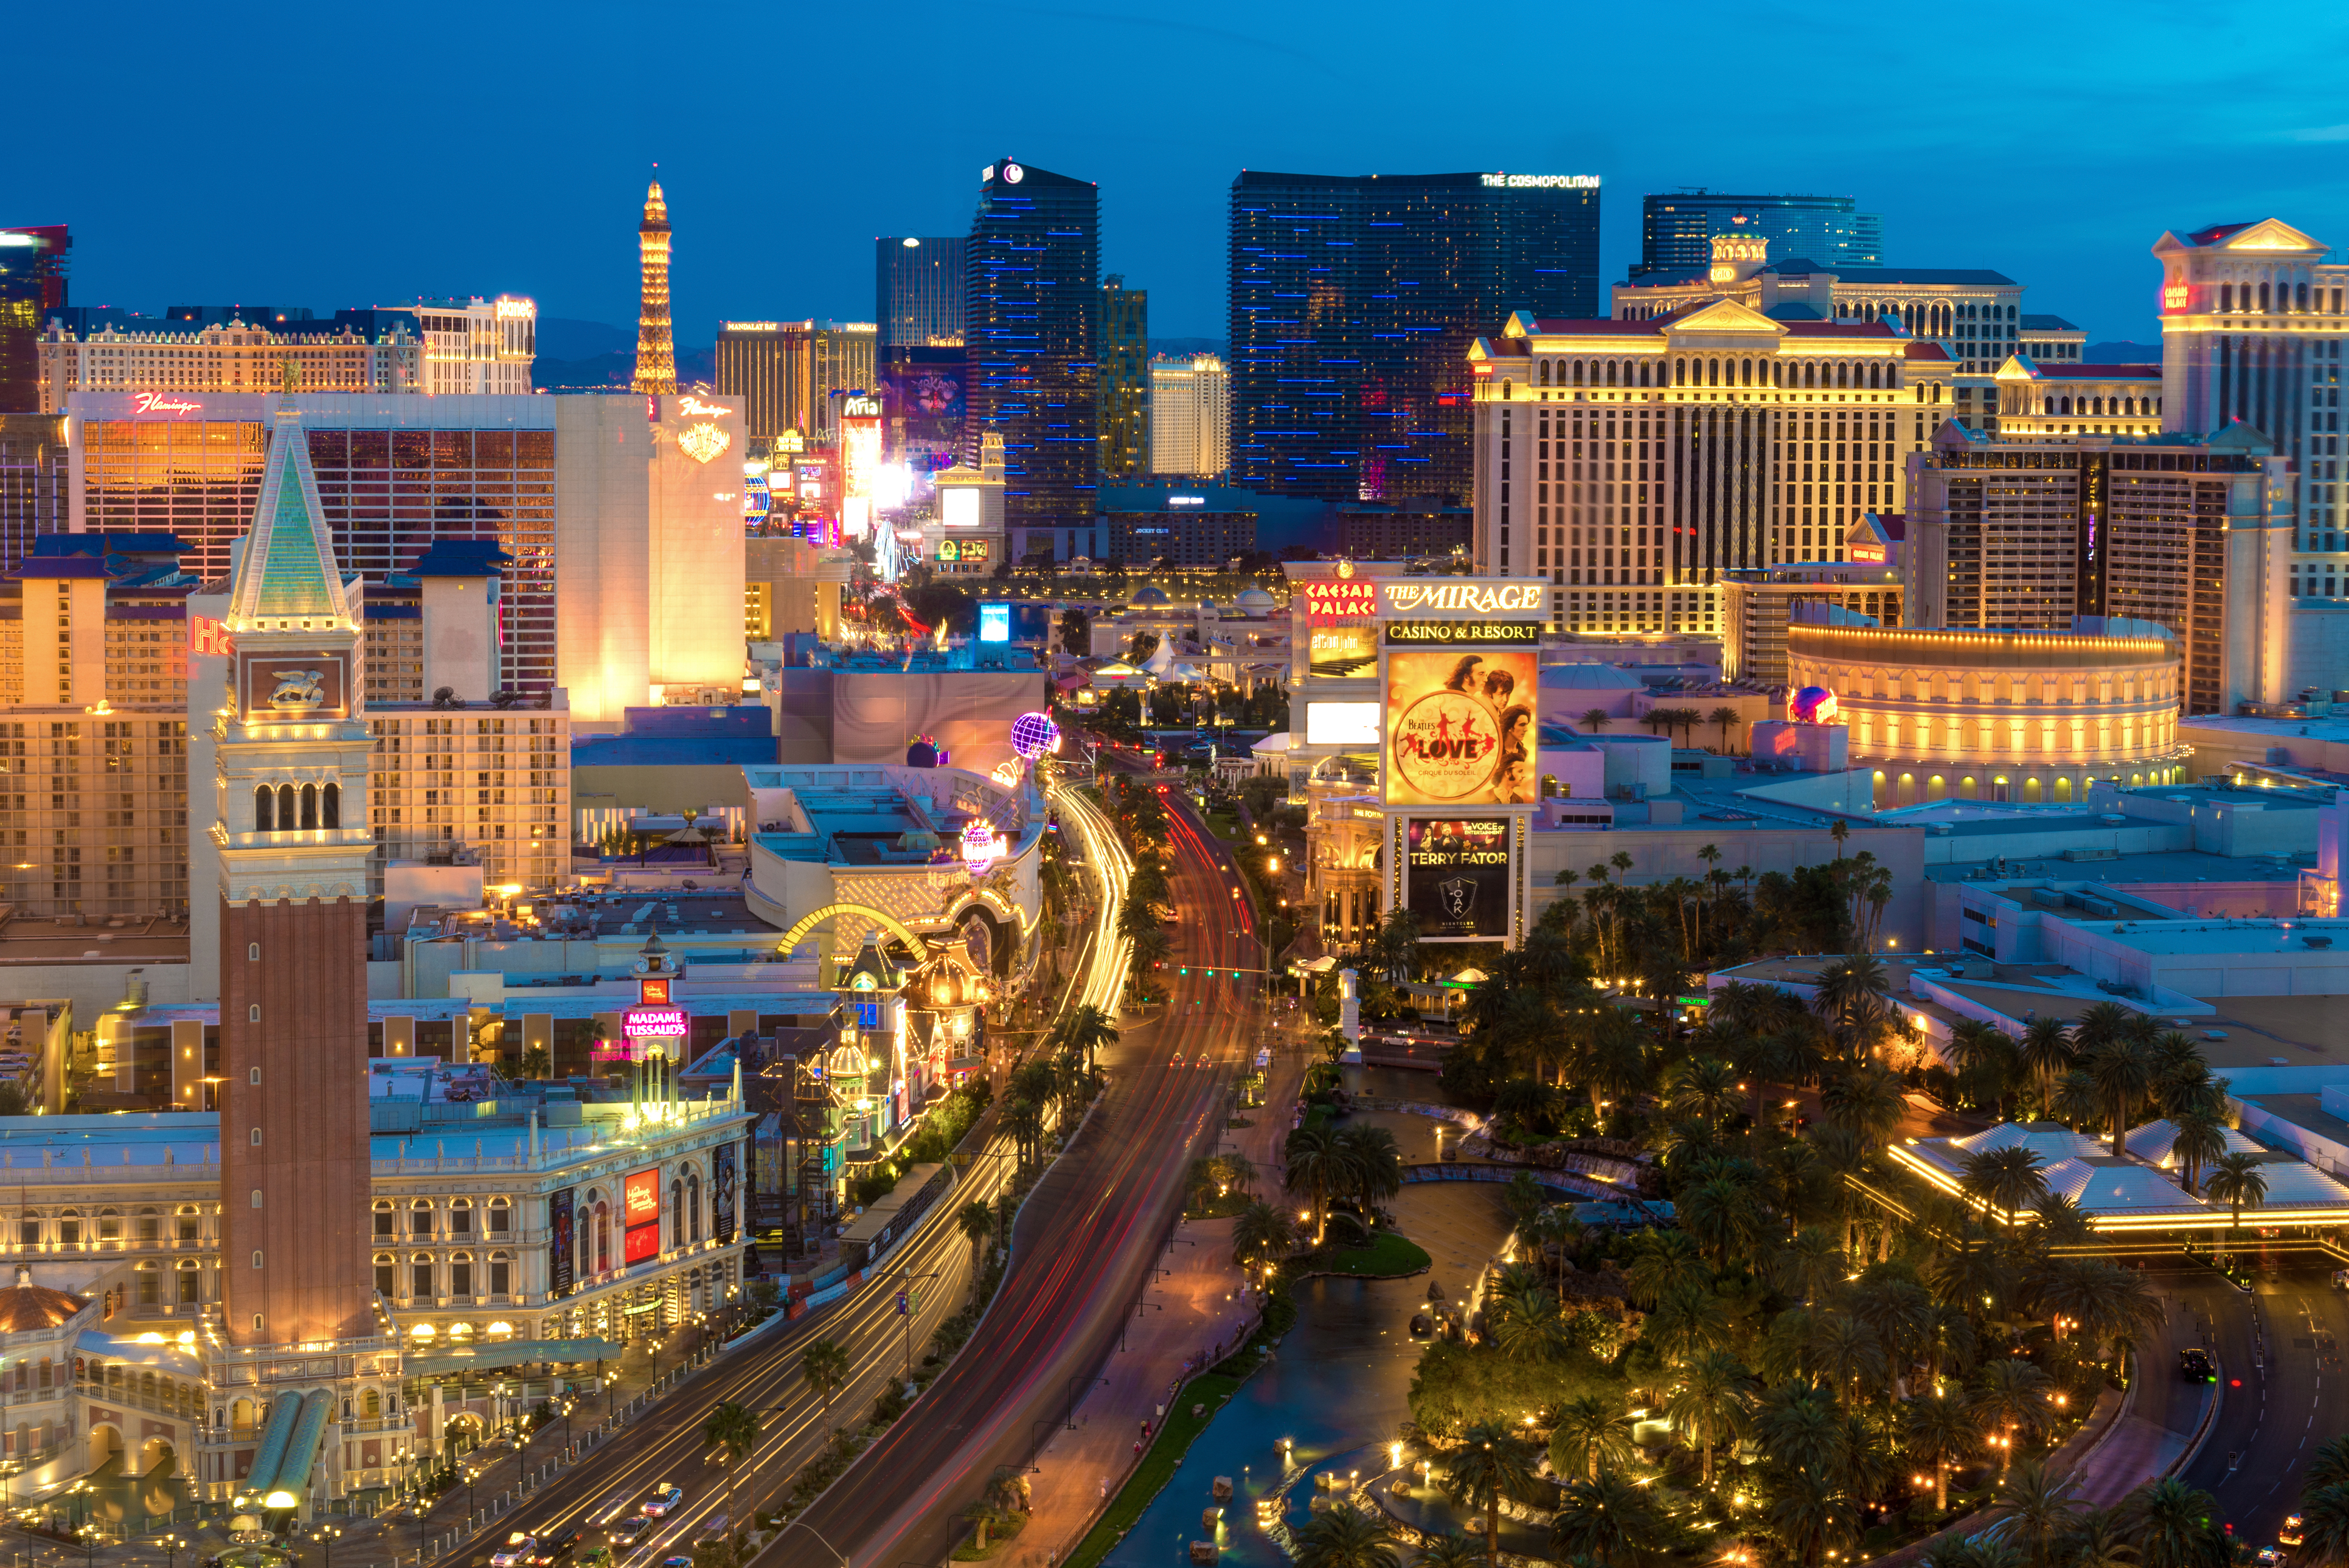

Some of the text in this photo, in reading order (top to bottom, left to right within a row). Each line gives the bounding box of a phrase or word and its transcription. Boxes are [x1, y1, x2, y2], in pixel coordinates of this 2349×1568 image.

[1482, 175, 1599, 187] THE COSMOPOLITAN
[497, 296, 533, 322] planet
[134, 392, 201, 416] Flamingo
[679, 397, 732, 418] Flamingo
[845, 397, 878, 410] Aria
[1385, 585, 1542, 613] THE MIRAGE
[1389, 625, 1536, 639] CASINO & RESORT
[1312, 633, 1358, 653] elton john
[1418, 739, 1478, 758] LOVE
[1365, 810, 1384, 819] FORUM
[1410, 852, 1508, 864] TERRY FATOR
[1454, 889, 1463, 914] OAK
[628, 1013, 682, 1024] MADAME
[624, 1023, 686, 1035] TUSSAUD'S
[627, 1185, 650, 1200] Madame
[628, 1193, 653, 1210] Tussauds
